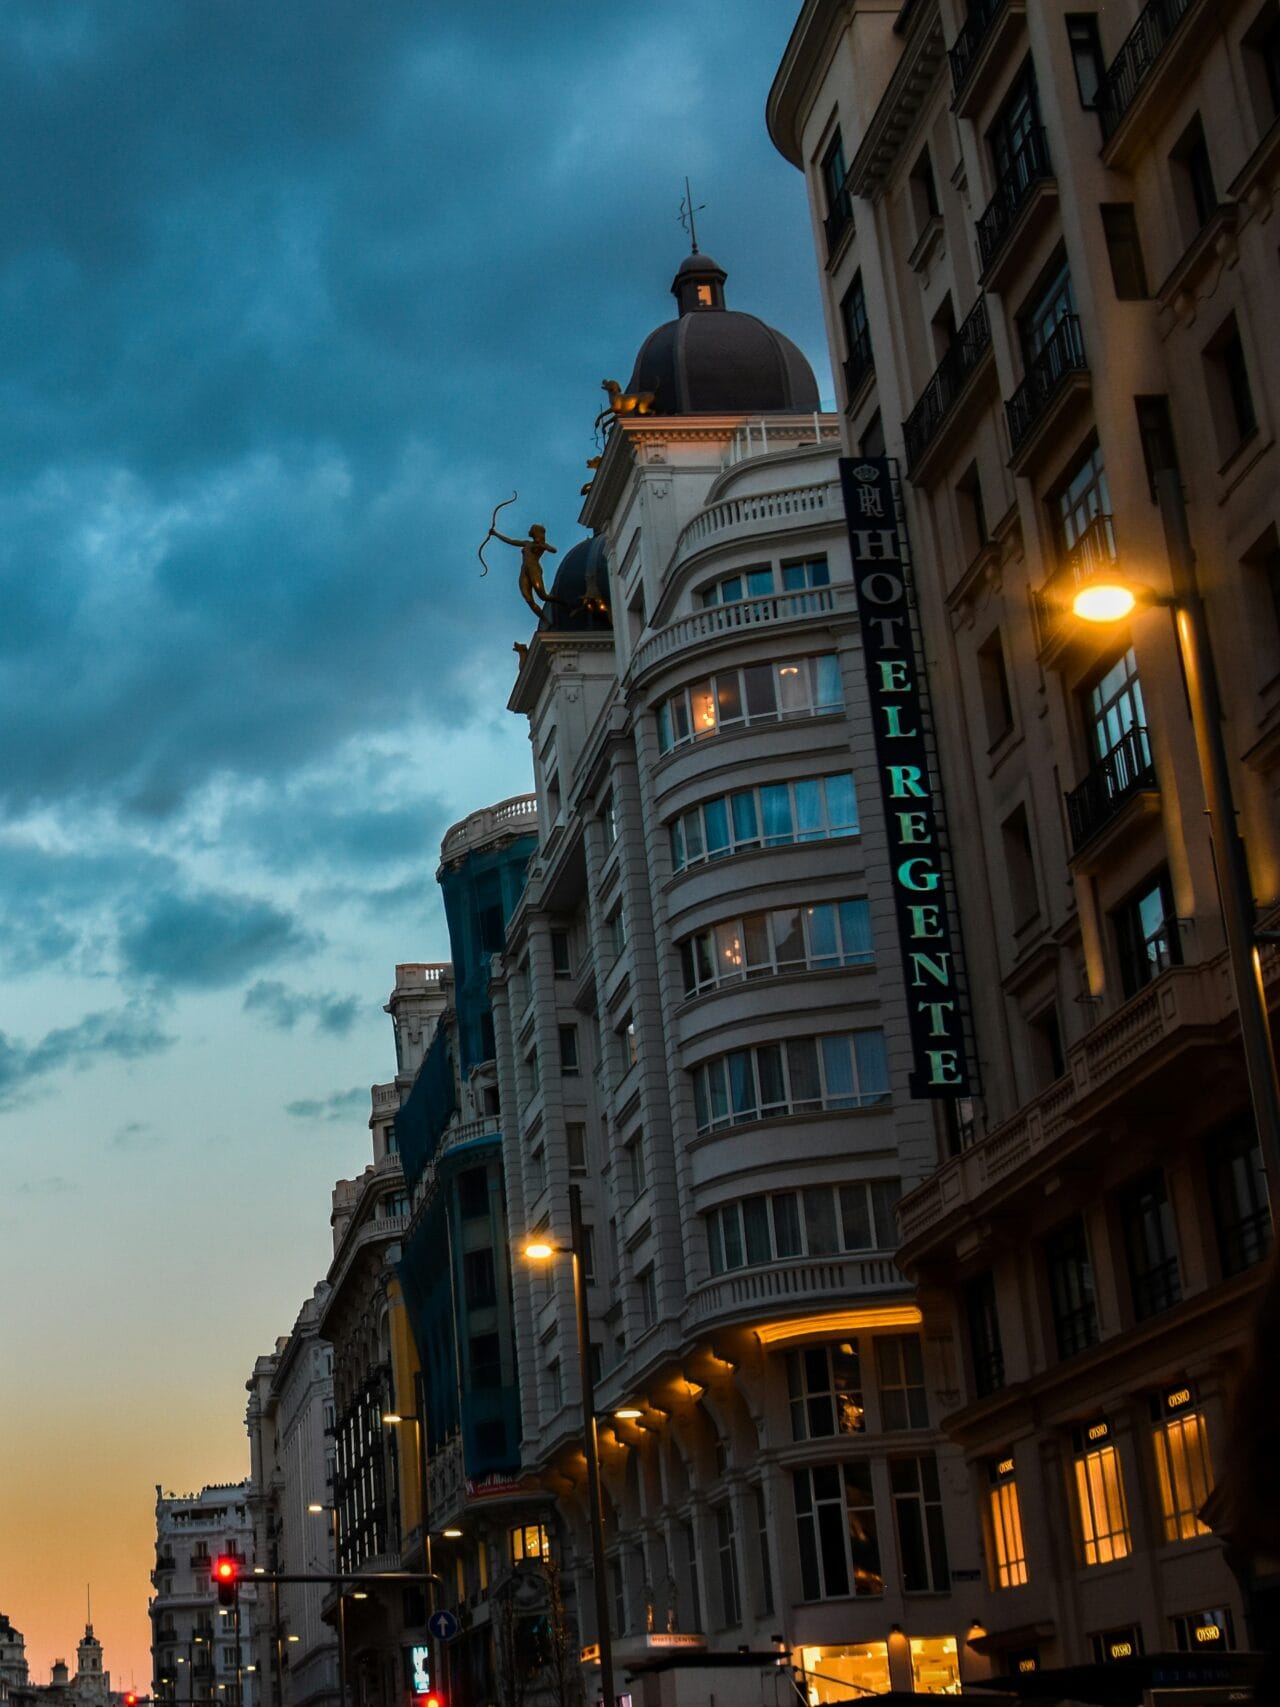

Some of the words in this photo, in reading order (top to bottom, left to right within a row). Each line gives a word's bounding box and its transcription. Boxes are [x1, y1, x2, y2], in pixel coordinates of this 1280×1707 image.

[852, 529, 917, 738] HOTEL
[885, 765, 963, 1086] REGENTE
[1167, 1388, 1190, 1408] OYSHO
[1088, 1423, 1108, 1440] OYSHO
[1196, 1625, 1220, 1642] OYSHO
[1111, 1643, 1131, 1658] OYSHO
[1019, 1658, 1035, 1672] OYSHO
